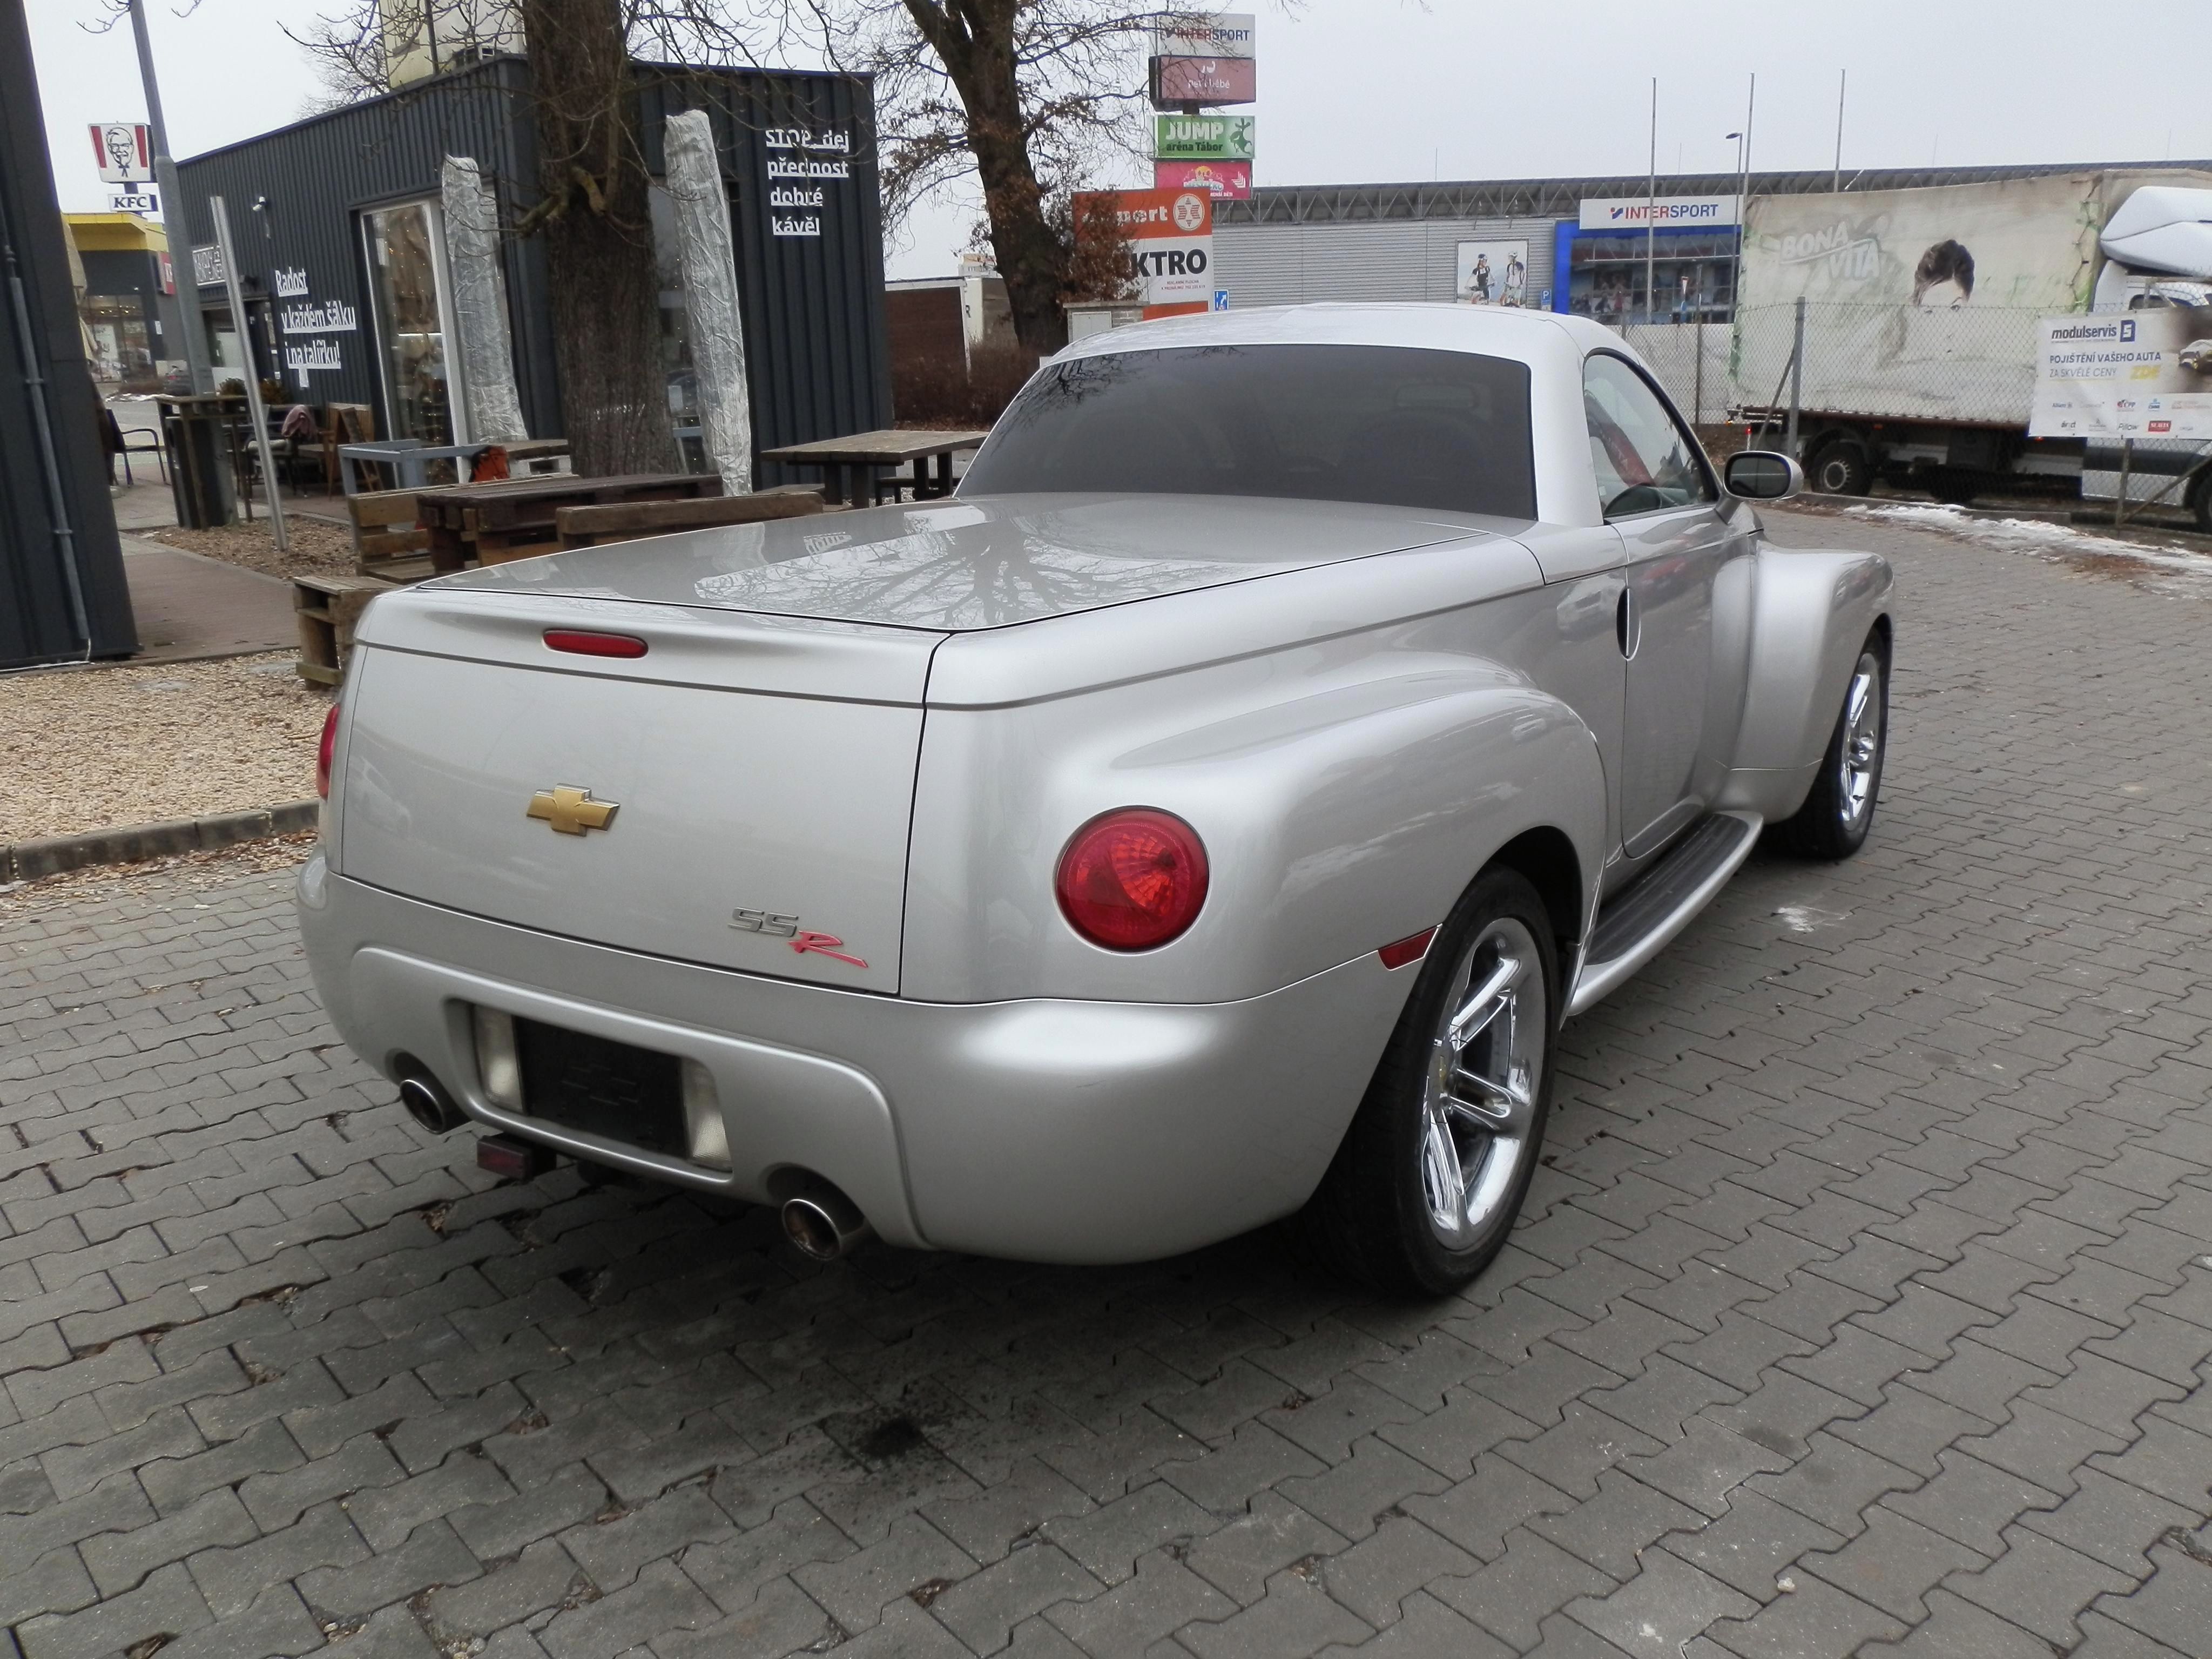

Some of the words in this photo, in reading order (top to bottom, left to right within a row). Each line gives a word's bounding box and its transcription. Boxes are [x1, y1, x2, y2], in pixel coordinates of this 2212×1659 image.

[1165, 122, 1224, 140] JUMP
[822, 130, 849, 153] dej
[1166, 141, 1193, 151] aréna
[1195, 141, 1223, 151] Tábor
[113, 196, 147, 208] KFC
[770, 187, 824, 204] dobré
[1625, 204, 1718, 219] INTERSPORT
[772, 216, 820, 233] kávě!
[1782, 221, 1849, 260] BONA
[1131, 248, 1208, 277] KTRO
[1829, 242, 1880, 278] VITA
[275, 266, 307, 293] Radost
[1543, 291, 1549, 299] P
[287, 304, 326, 329] každém
[326, 300, 356, 327] šálku
[2051, 324, 2117, 340] modulservis
[290, 347, 304, 365] na
[2050, 352, 2096, 363] POJIŠTĚNÍ
[2098, 352, 2134, 362] VAŠEHO
[2136, 352, 2161, 361] AUTA
[2049, 368, 2058, 377] ZA
[2060, 367, 2091, 377] SKVĚLÉ
[2093, 367, 2117, 376] CENY
